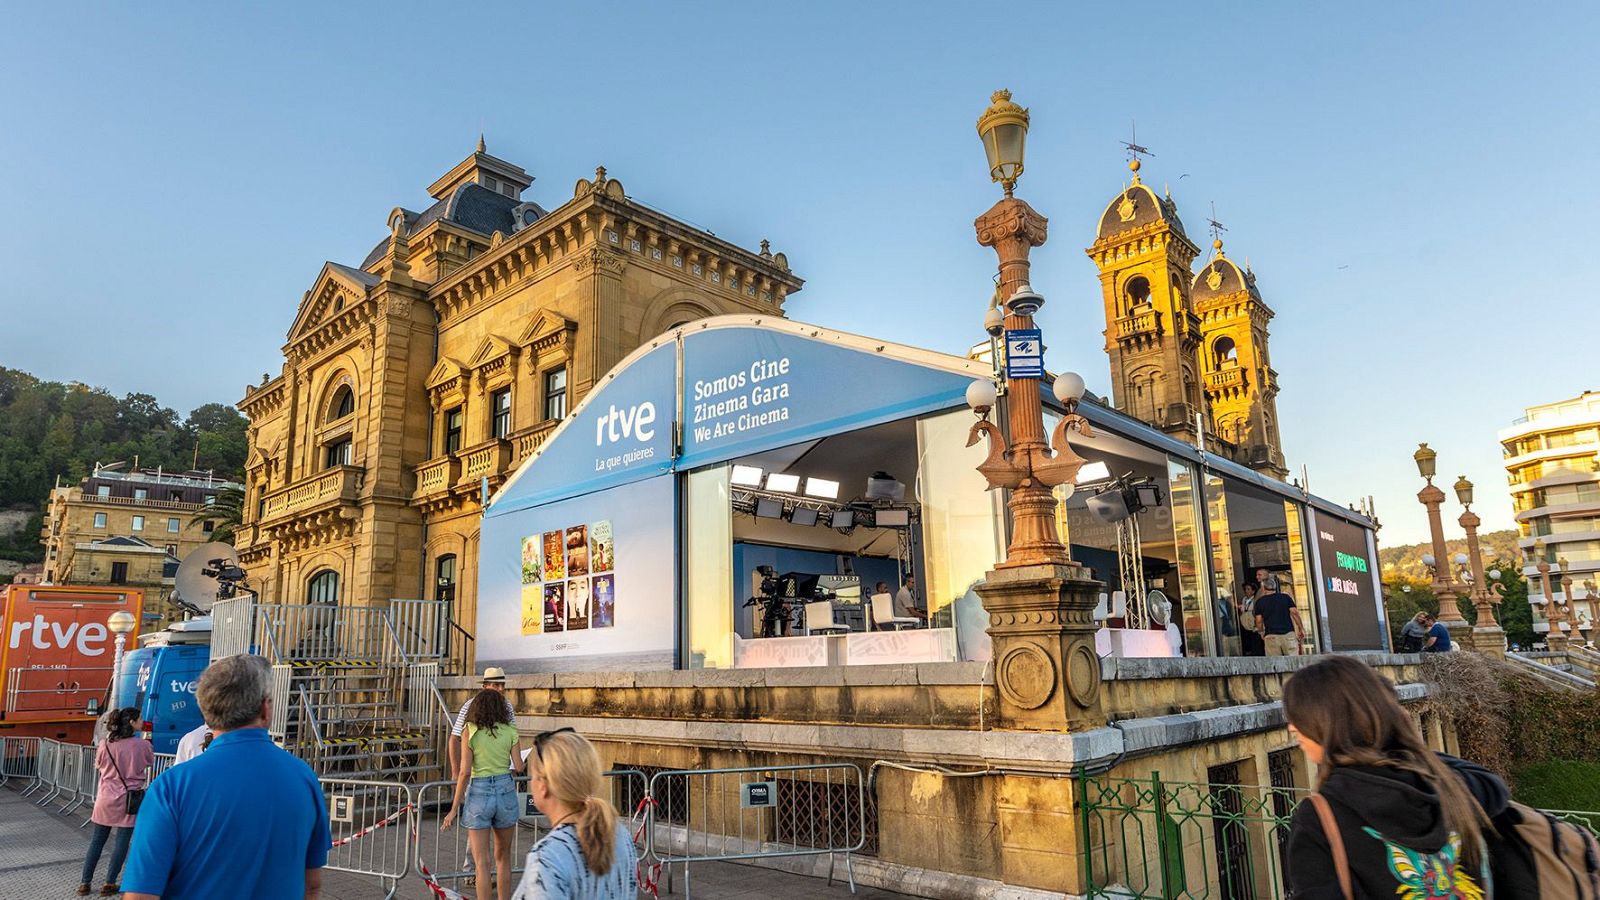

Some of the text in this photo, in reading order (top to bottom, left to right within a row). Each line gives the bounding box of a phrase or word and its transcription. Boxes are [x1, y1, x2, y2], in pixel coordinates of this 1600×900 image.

[694, 357, 790, 401] Somos Cine
[596, 401, 656, 446] rtve
[693, 383, 789, 424] Zinema Gara
[693, 407, 789, 444] We Are Cinema
[595, 447, 655, 471] La que quieres
[9, 614, 108, 656] rtve
[171, 700, 187, 711] HD
